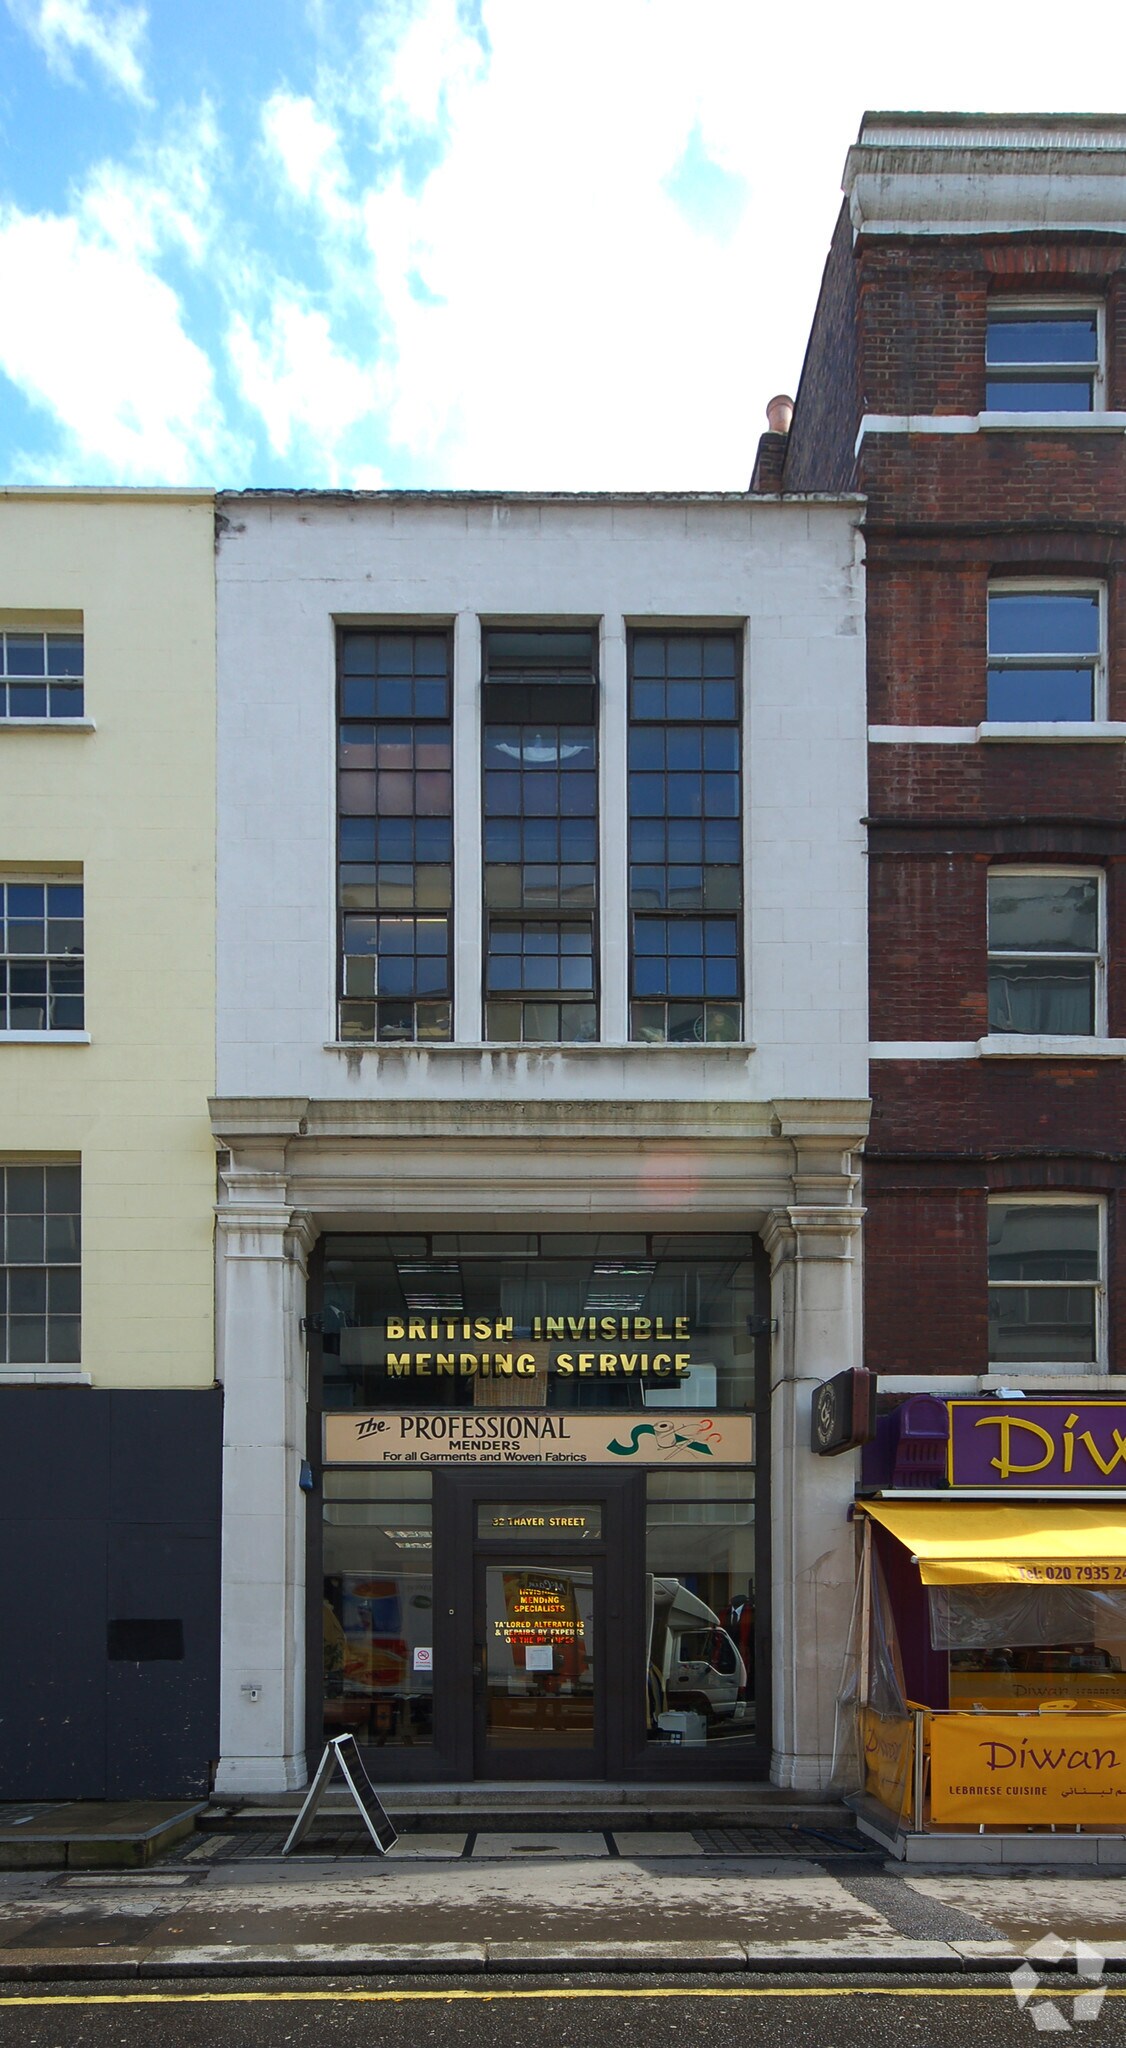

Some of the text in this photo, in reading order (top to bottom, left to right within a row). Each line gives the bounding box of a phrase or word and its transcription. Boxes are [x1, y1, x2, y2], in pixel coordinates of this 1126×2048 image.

[386, 1316, 691, 1342] BRITISH INVISIBLE
[386, 1352, 691, 1378] MENDING SERVICE
[355, 1416, 570, 1440] The PROFESSIONAL
[449, 1441, 520, 1451] MENDERS
[383, 1452, 587, 1462] For all Garments and Woven Fabrics
[508, 1517, 545, 1526] THAYER
[549, 1517, 586, 1526] STREET
[1017, 1566, 1043, 1580] Tel:
[1046, 1566, 1072, 1580] 020
[1075, 1566, 1110, 1580] 7935
[520, 1596, 560, 1604] MENDING
[514, 1605, 566, 1613] SPECIALISTS
[505, 1636, 516, 1644] ON
[1012, 1684, 1069, 1697] Diwan
[979, 1737, 1121, 1771] Diwan
[949, 1785, 1048, 1795] LEBANESE CUISINE
